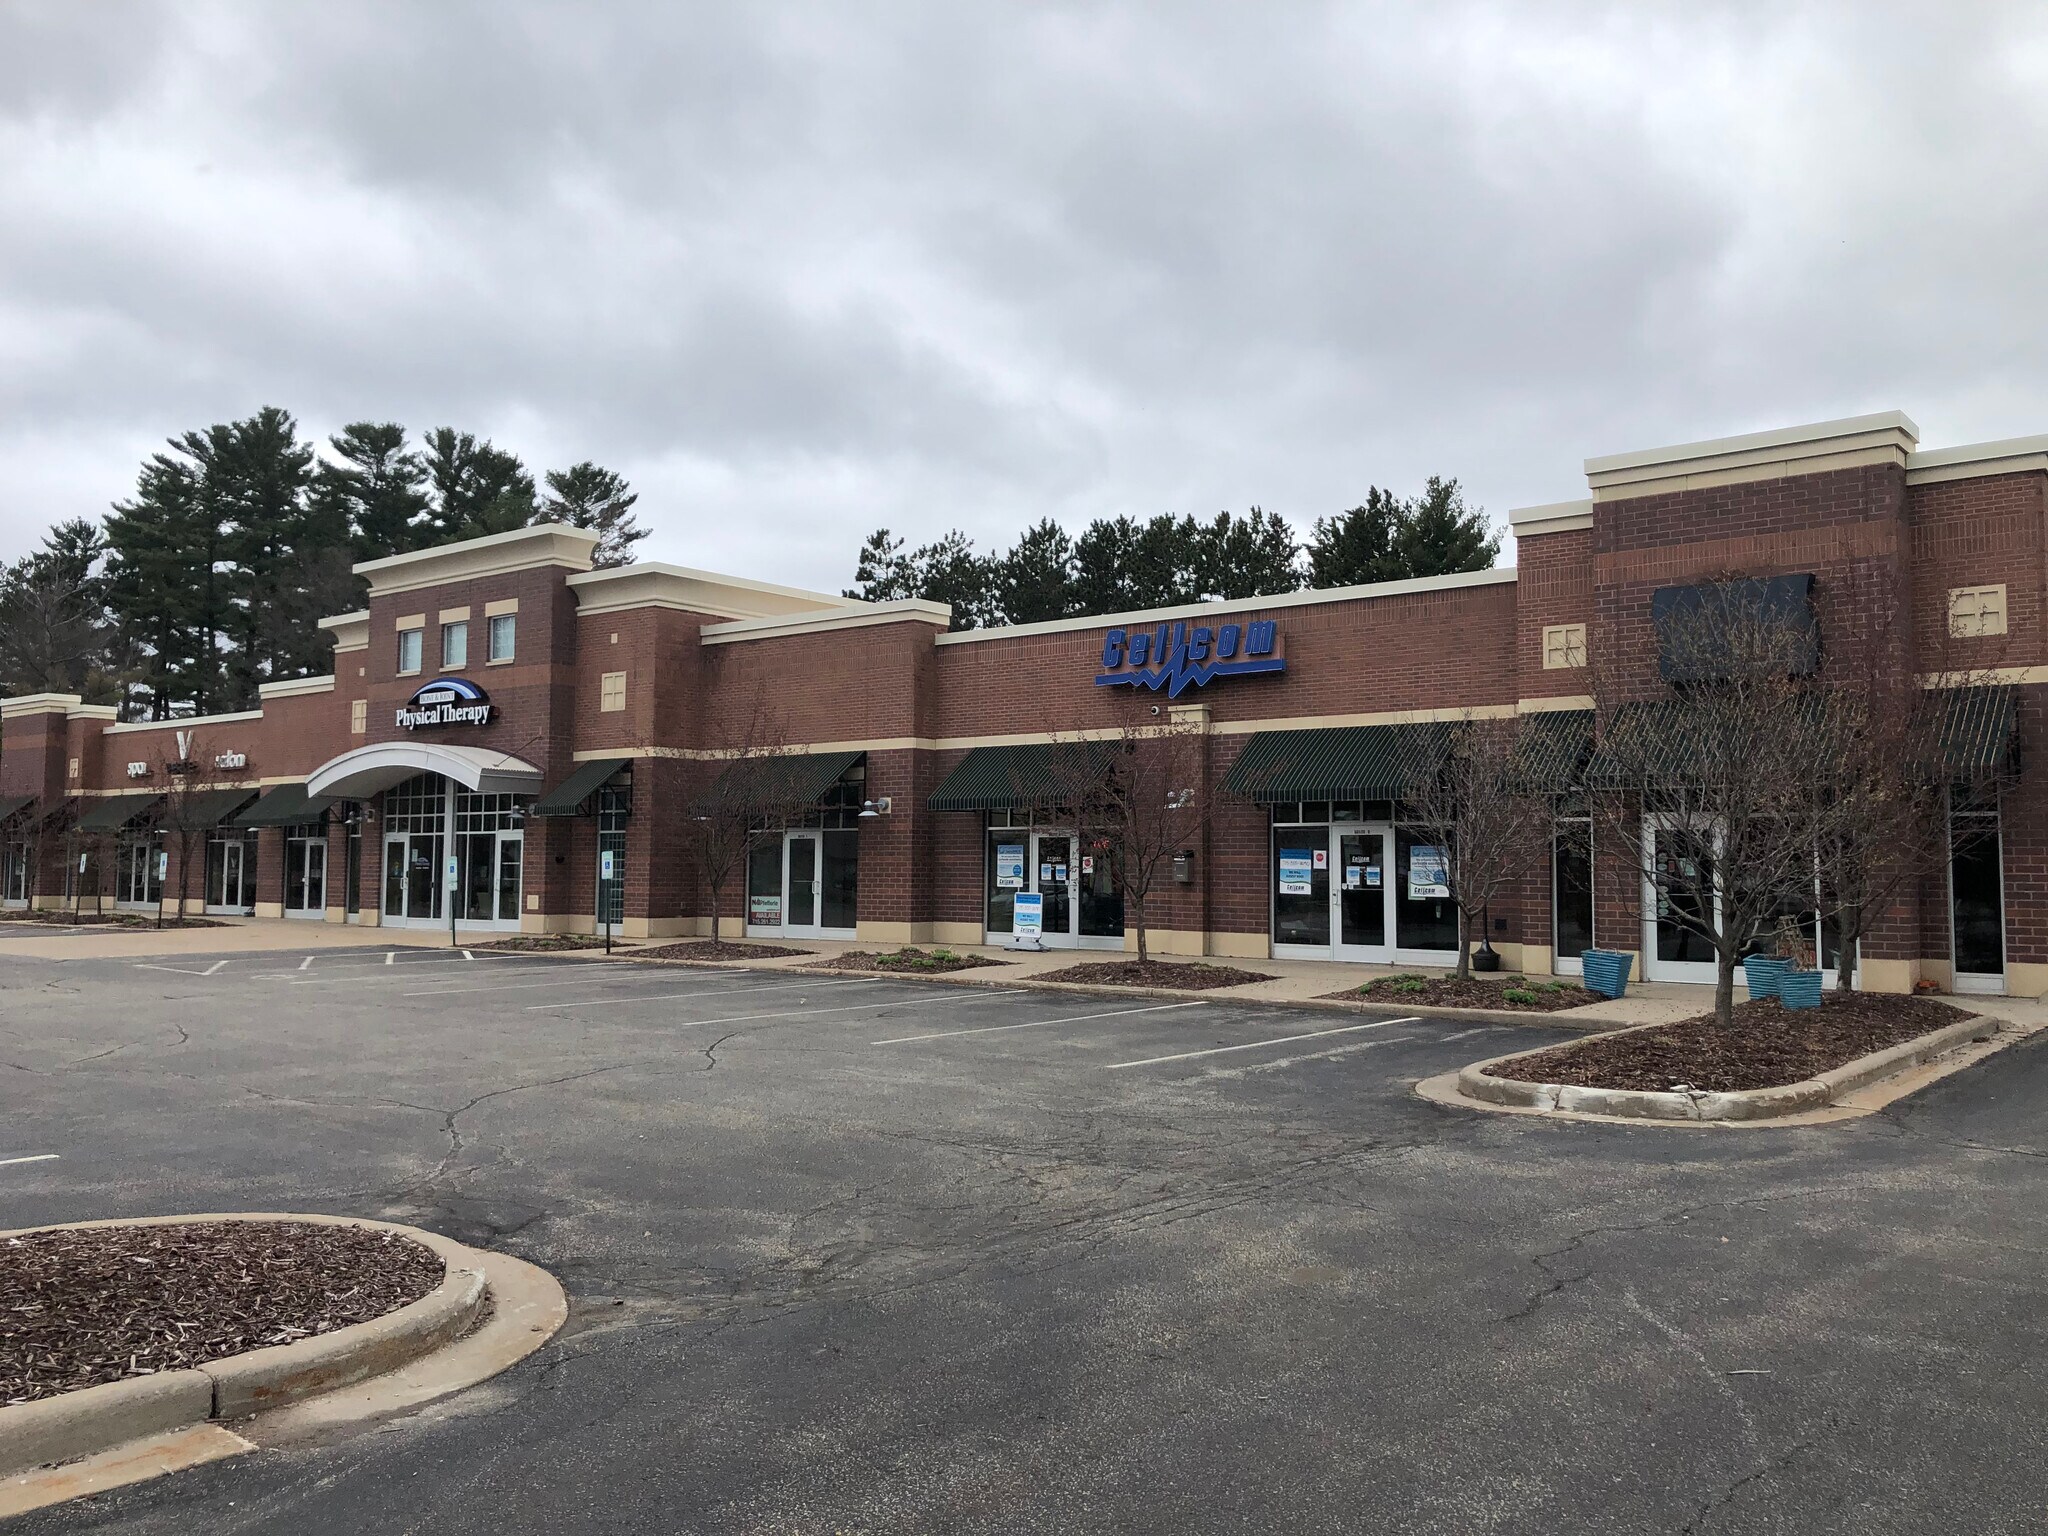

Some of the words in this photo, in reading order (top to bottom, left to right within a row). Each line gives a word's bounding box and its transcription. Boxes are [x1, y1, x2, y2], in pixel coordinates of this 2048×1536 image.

[1103, 620, 1277, 668] Cellcom
[396, 705, 440, 730] Physical
[442, 704, 490, 724] Therapy
